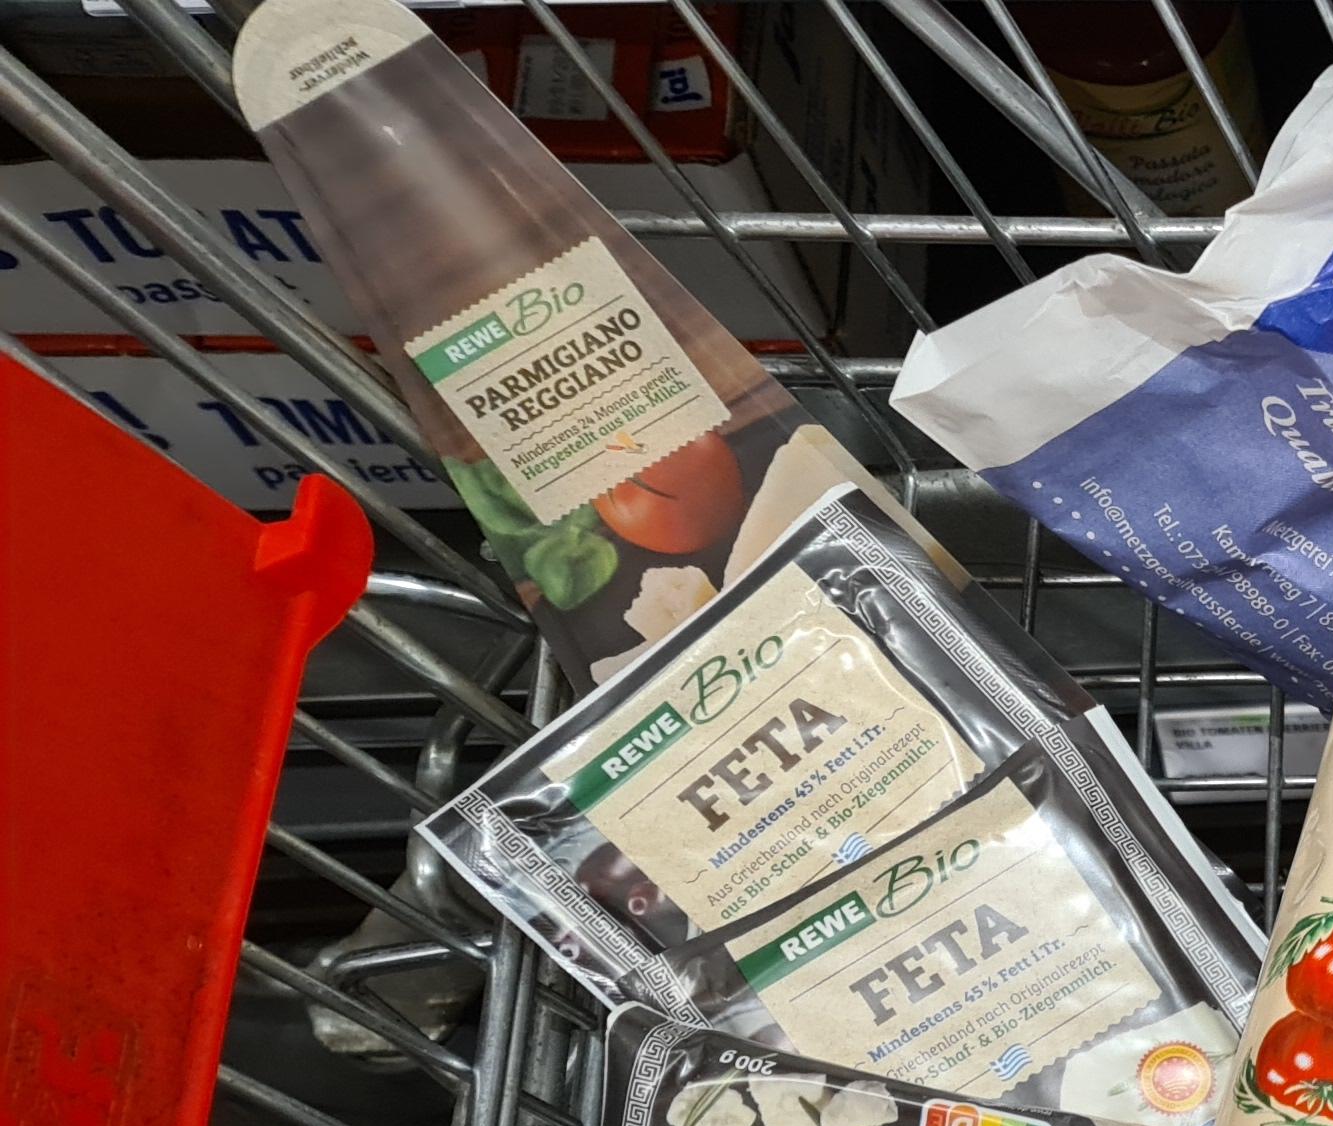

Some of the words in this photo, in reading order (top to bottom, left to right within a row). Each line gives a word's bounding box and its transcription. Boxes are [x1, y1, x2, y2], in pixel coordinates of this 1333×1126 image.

[445, 319, 507, 364] REWE
[505, 282, 585, 337] Bio
[465, 308, 642, 419] PARMIGIANO
[499, 340, 642, 432] REGGIANO
[510, 424, 581, 469] Mindestens
[596, 392, 638, 423] Monate
[637, 367, 683, 401] gereift.
[521, 433, 599, 481] Hergestellt
[599, 416, 624, 437] aus
[623, 381, 691, 422] Bio-Milch.
[1153, 502, 1184, 540] Tel.:
[1292, 630, 1322, 664] Fax:
[601, 710, 683, 781] REWE
[680, 635, 784, 726] Bio
[675, 697, 848, 833] FETA
[707, 882, 734, 908] Aus
[731, 820, 812, 886] Griechenland
[810, 791, 844, 825] nach
[839, 723, 927, 798] Originalrezept
[708, 797, 796, 870] Mindestens
[823, 745, 861, 777] Fett
[720, 896, 748, 921] aus
[745, 836, 815, 898] Bio-Schaf-
[826, 737, 940, 830] Bio-Ziegenmilch.
[779, 901, 866, 963] REWE
[873, 838, 981, 919] Bio
[849, 903, 1030, 1027] FETA
[867, 1000, 963, 1063] Mindestens
[997, 958, 1030, 985] Fett
[976, 996, 1011, 1026] nach
[1010, 944, 1105, 1004] Originalrezept
[992, 959, 1118, 1039] Bio-Ziegenmilch.
